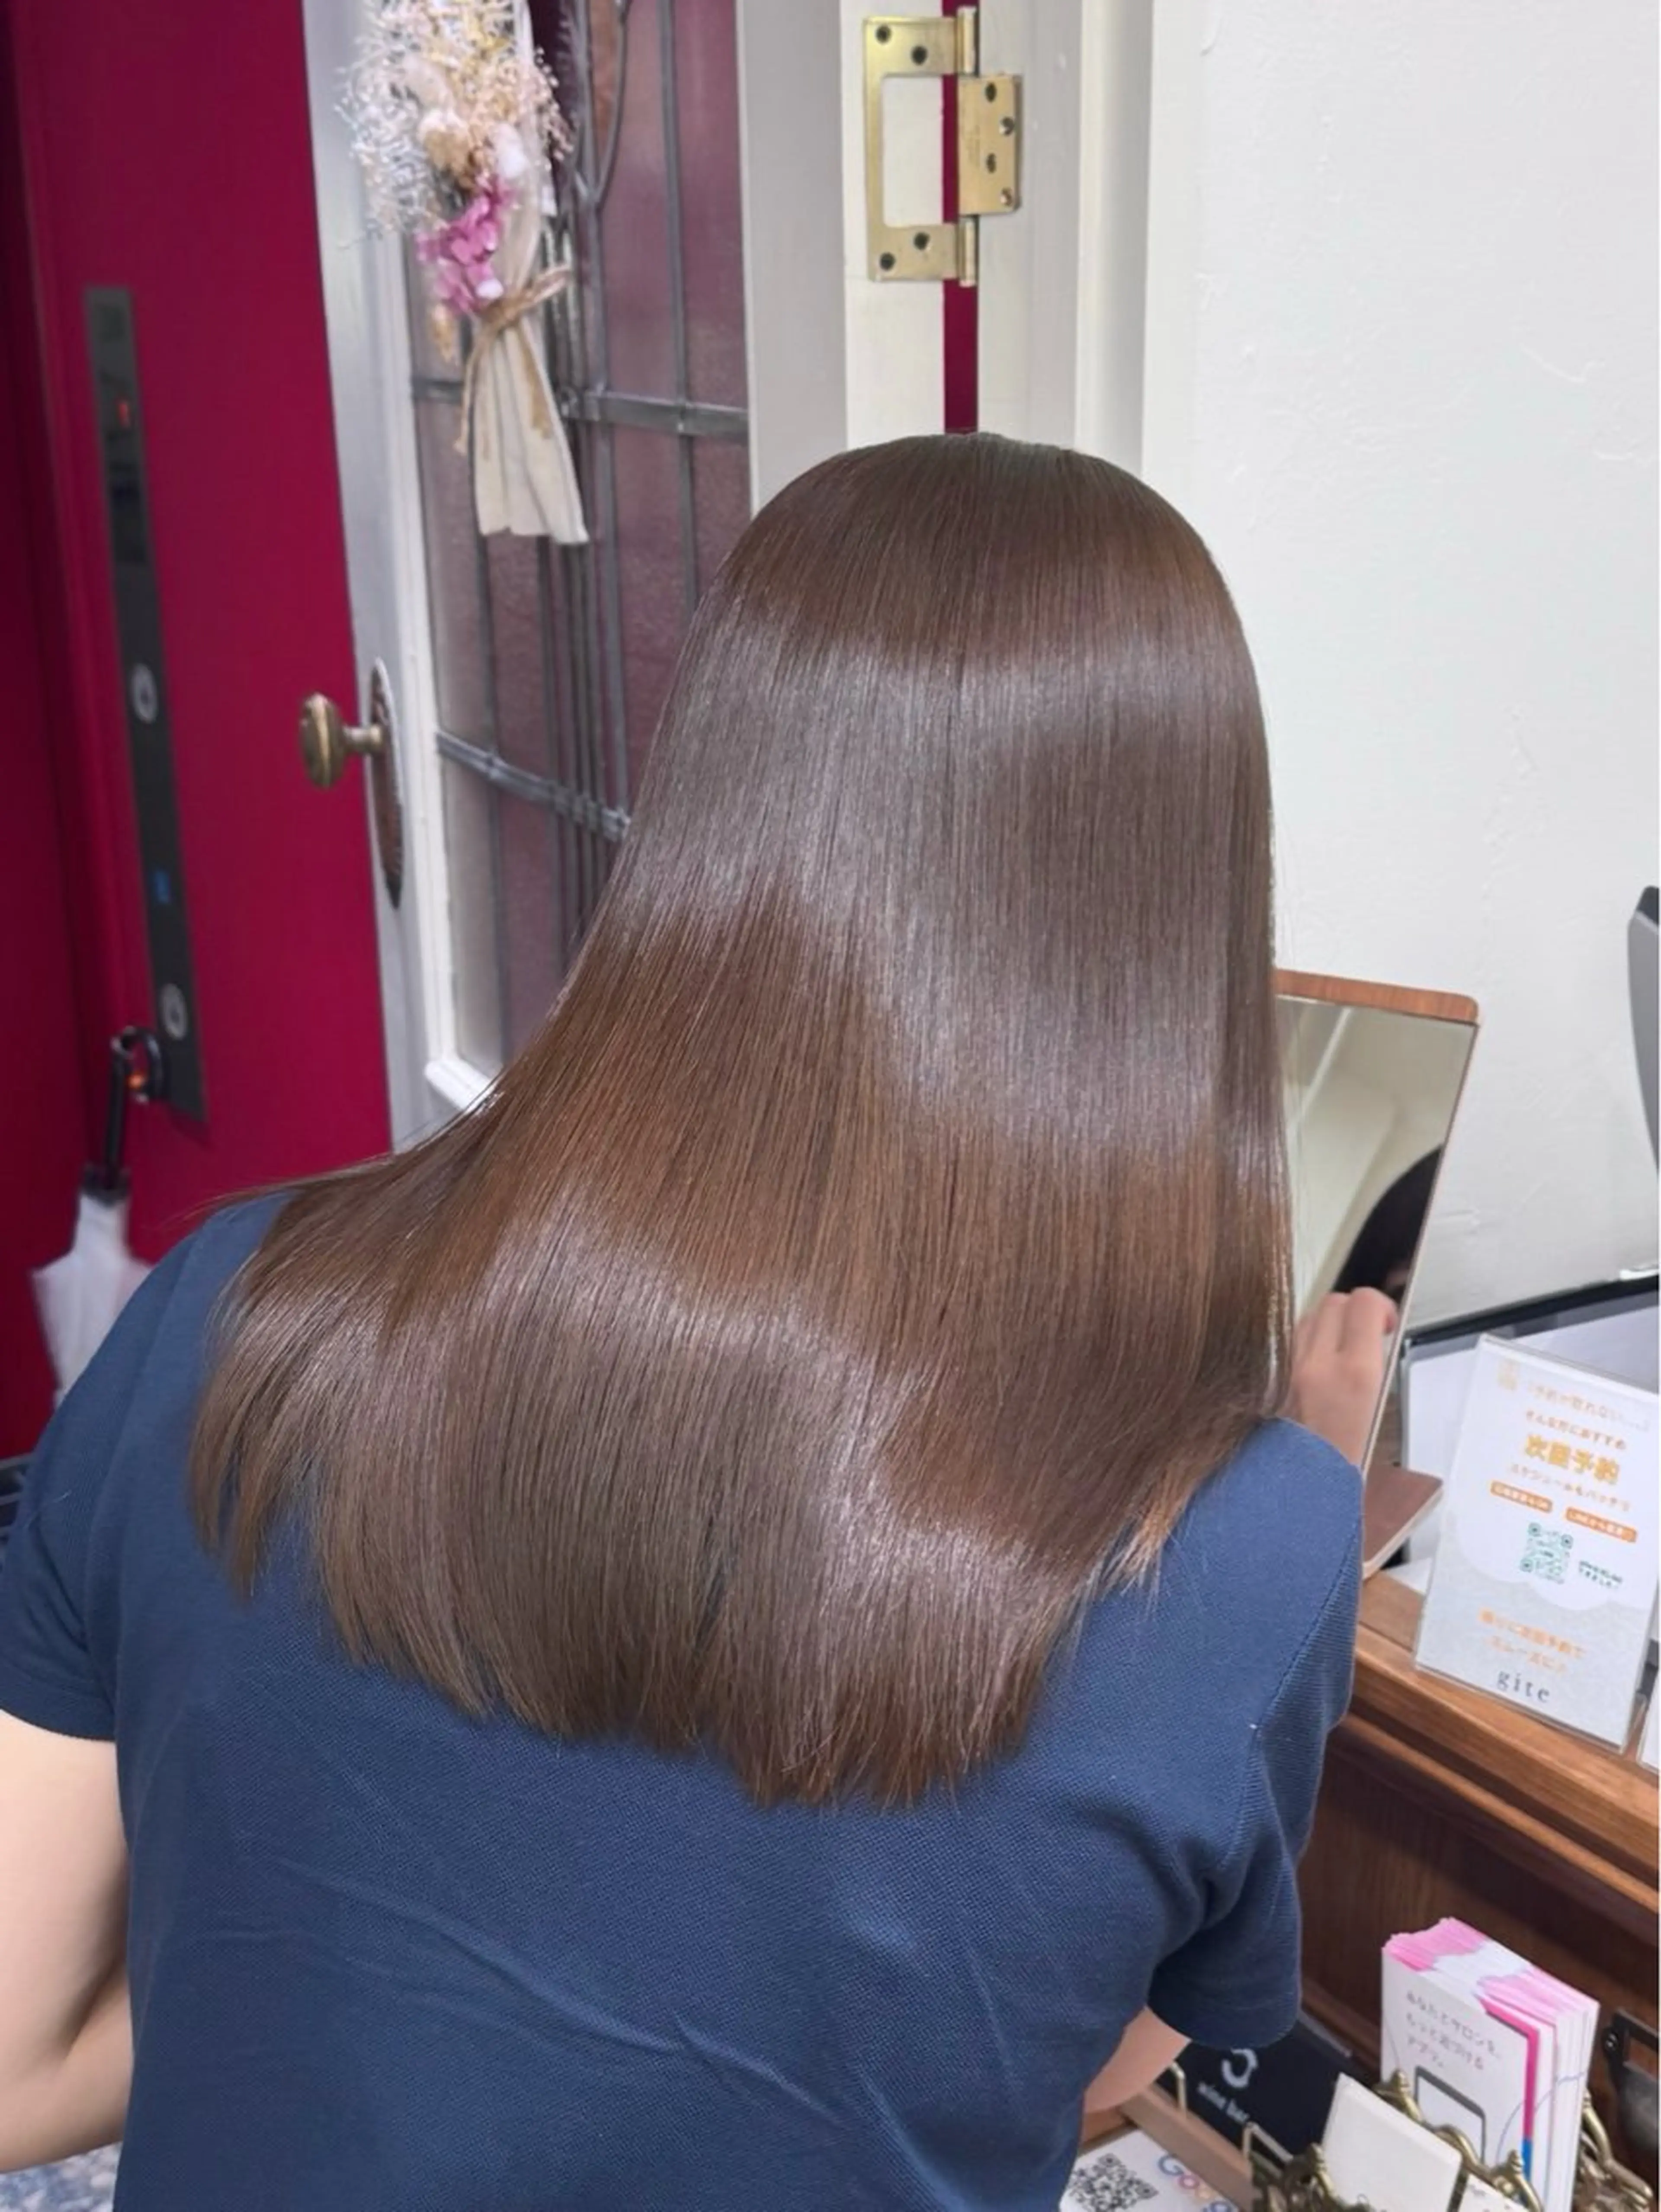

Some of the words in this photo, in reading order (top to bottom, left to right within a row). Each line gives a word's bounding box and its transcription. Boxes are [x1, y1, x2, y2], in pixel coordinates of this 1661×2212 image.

[1526, 1434, 1619, 1484] 次回予約
[1497, 1671, 1549, 1702] gite
